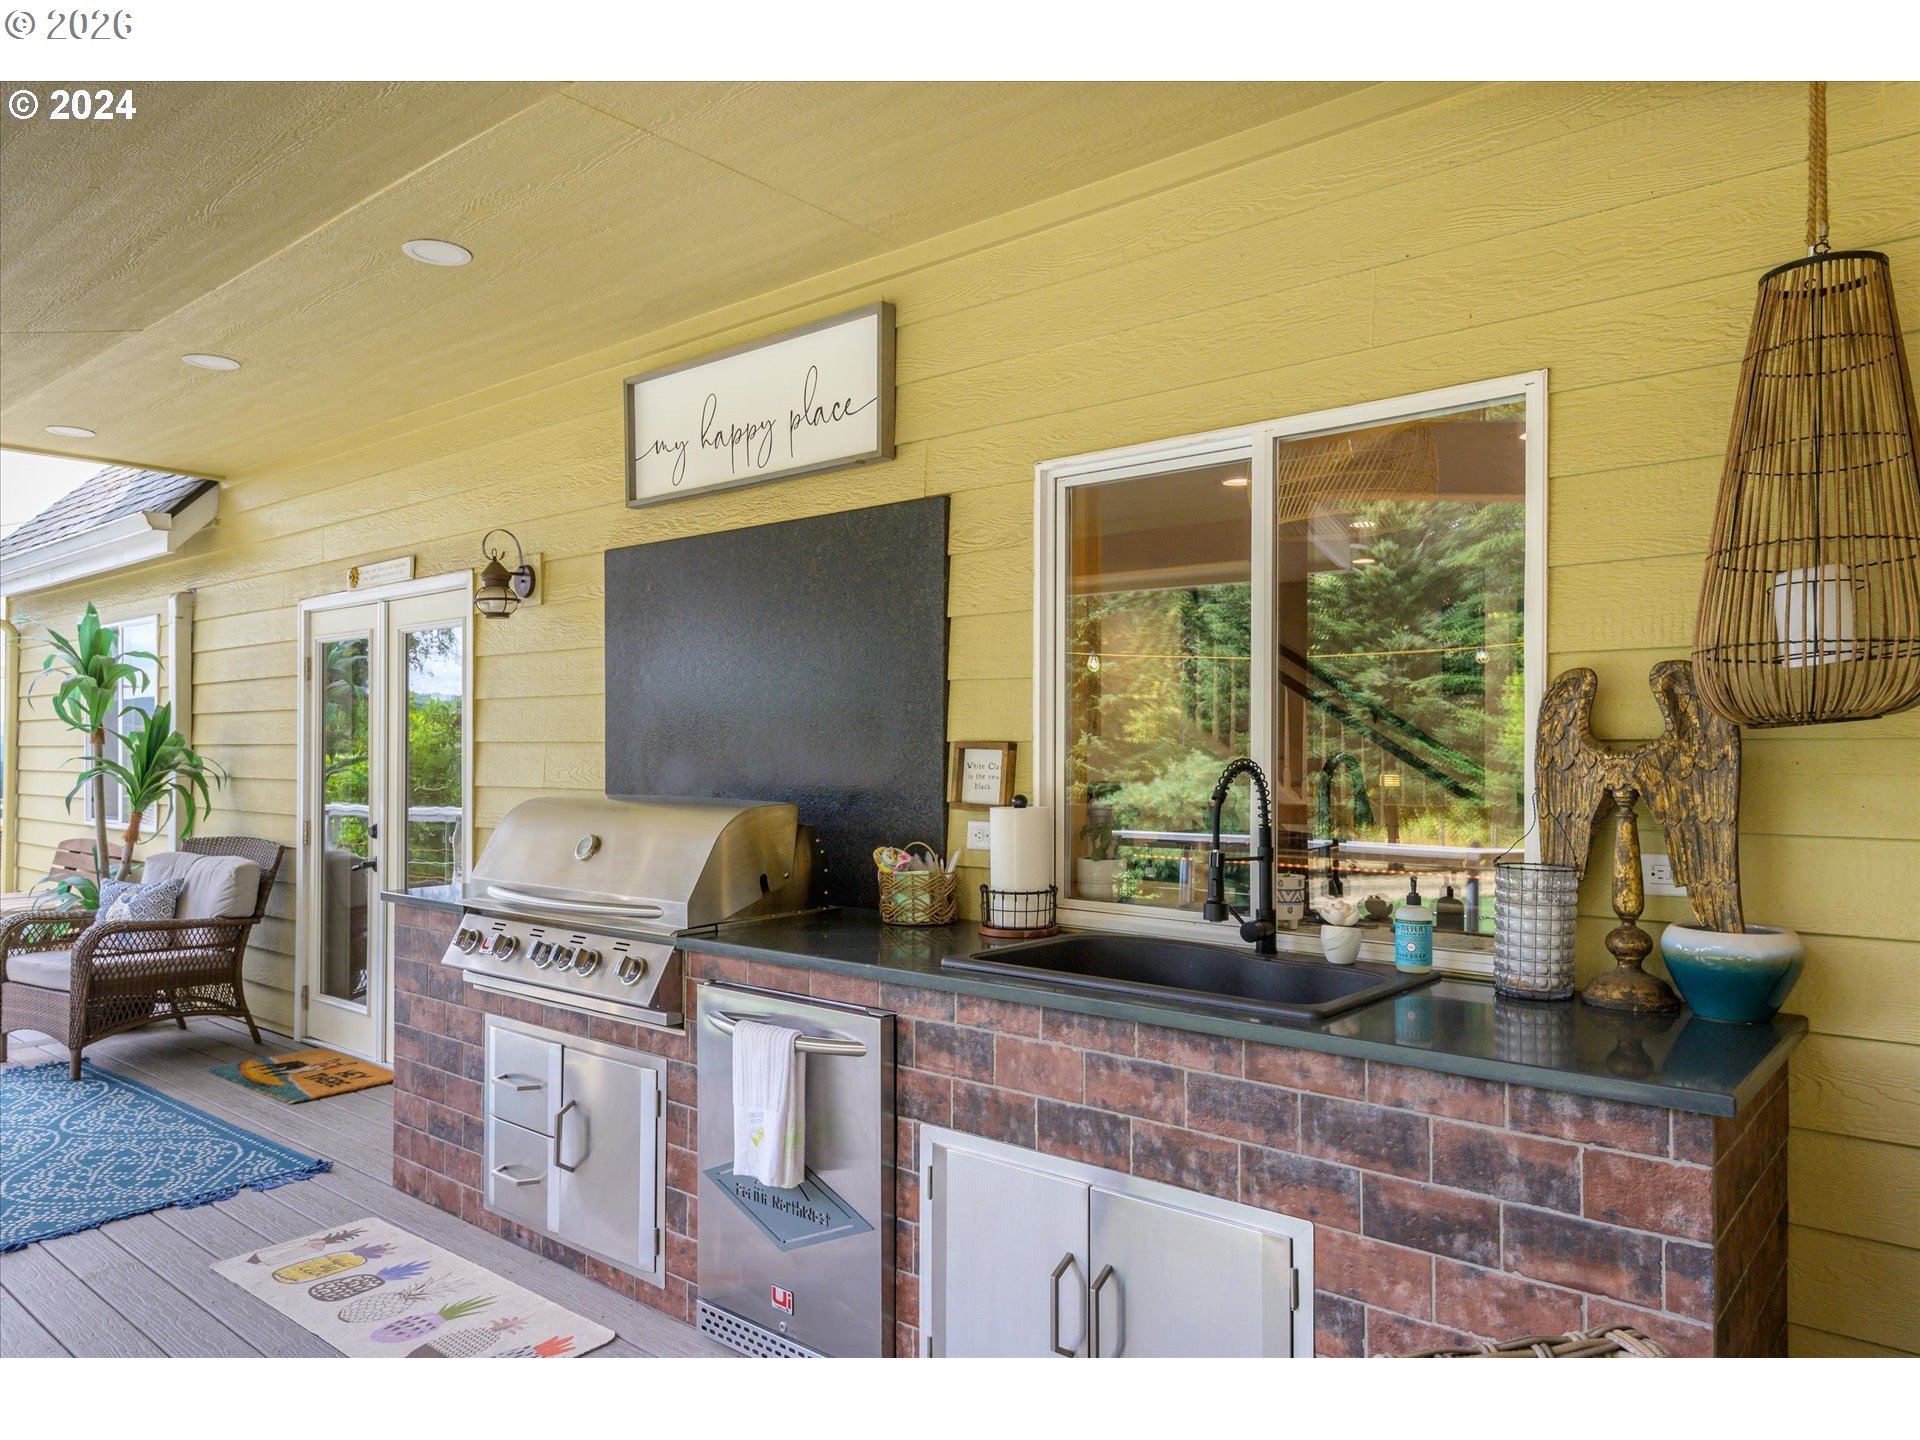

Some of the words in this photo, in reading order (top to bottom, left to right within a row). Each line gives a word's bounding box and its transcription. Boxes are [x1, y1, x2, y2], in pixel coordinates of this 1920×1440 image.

[635, 438, 689, 486] my
[701, 393, 776, 474] happy
[790, 365, 877, 458] place
[966, 762, 985, 770] White
[988, 762, 999, 770] Cla
